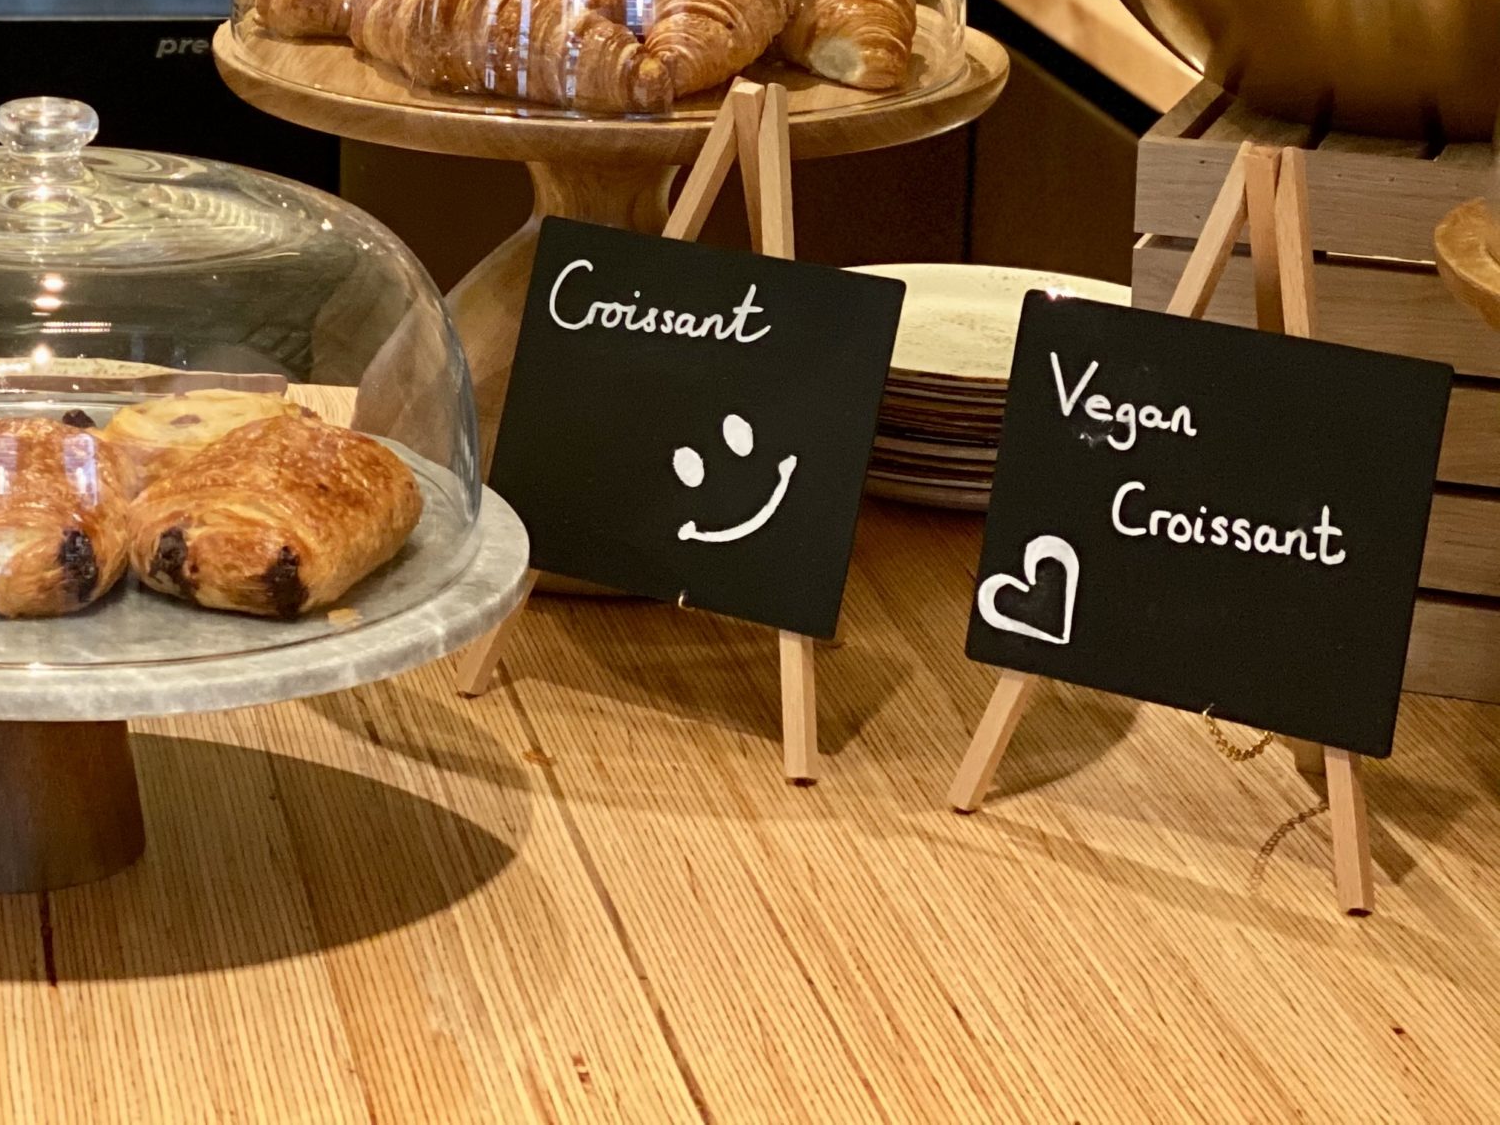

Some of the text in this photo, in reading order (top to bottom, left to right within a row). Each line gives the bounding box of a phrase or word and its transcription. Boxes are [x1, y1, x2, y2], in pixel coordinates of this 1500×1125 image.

[155, 38, 211, 59] pre
[548, 258, 773, 344] Croissant
[1049, 350, 1198, 452] Vegan
[1110, 480, 1347, 566] Croissant
